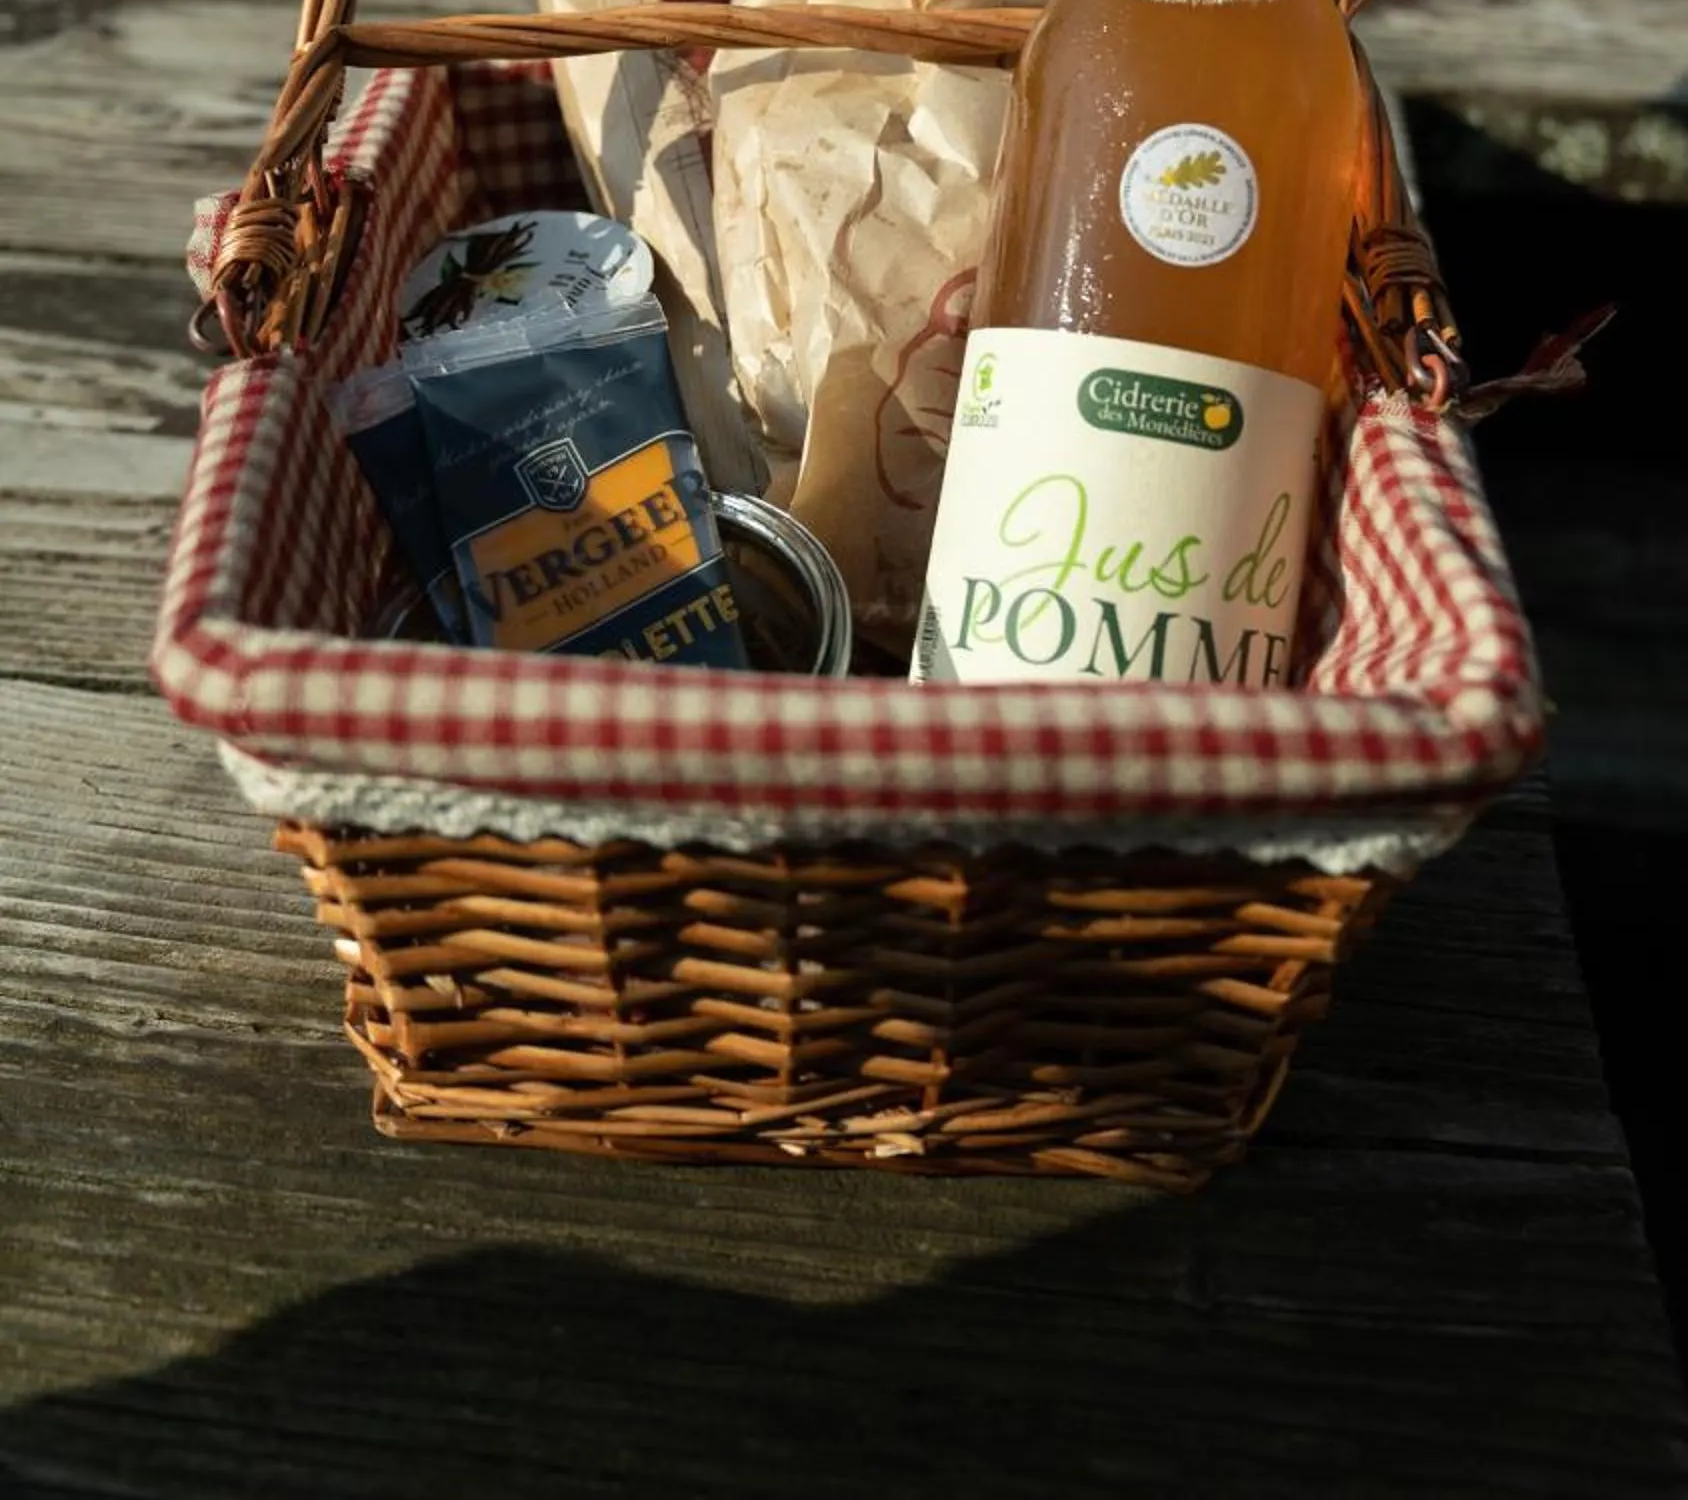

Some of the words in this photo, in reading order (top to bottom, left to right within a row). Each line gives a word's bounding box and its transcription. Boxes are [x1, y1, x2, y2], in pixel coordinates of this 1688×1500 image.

[1144, 187, 1231, 215] ÉDAILLE
[1089, 376, 1199, 419] Cidrerie
[1097, 403, 1122, 421] des
[1128, 411, 1223, 446] Monédières
[467, 469, 709, 622] VERGEER
[551, 542, 669, 617] HOLLAND
[972, 473, 1210, 642] Jus
[1223, 492, 1290, 608] de
[598, 583, 739, 661] LETTE
[951, 577, 1286, 687] POMME
